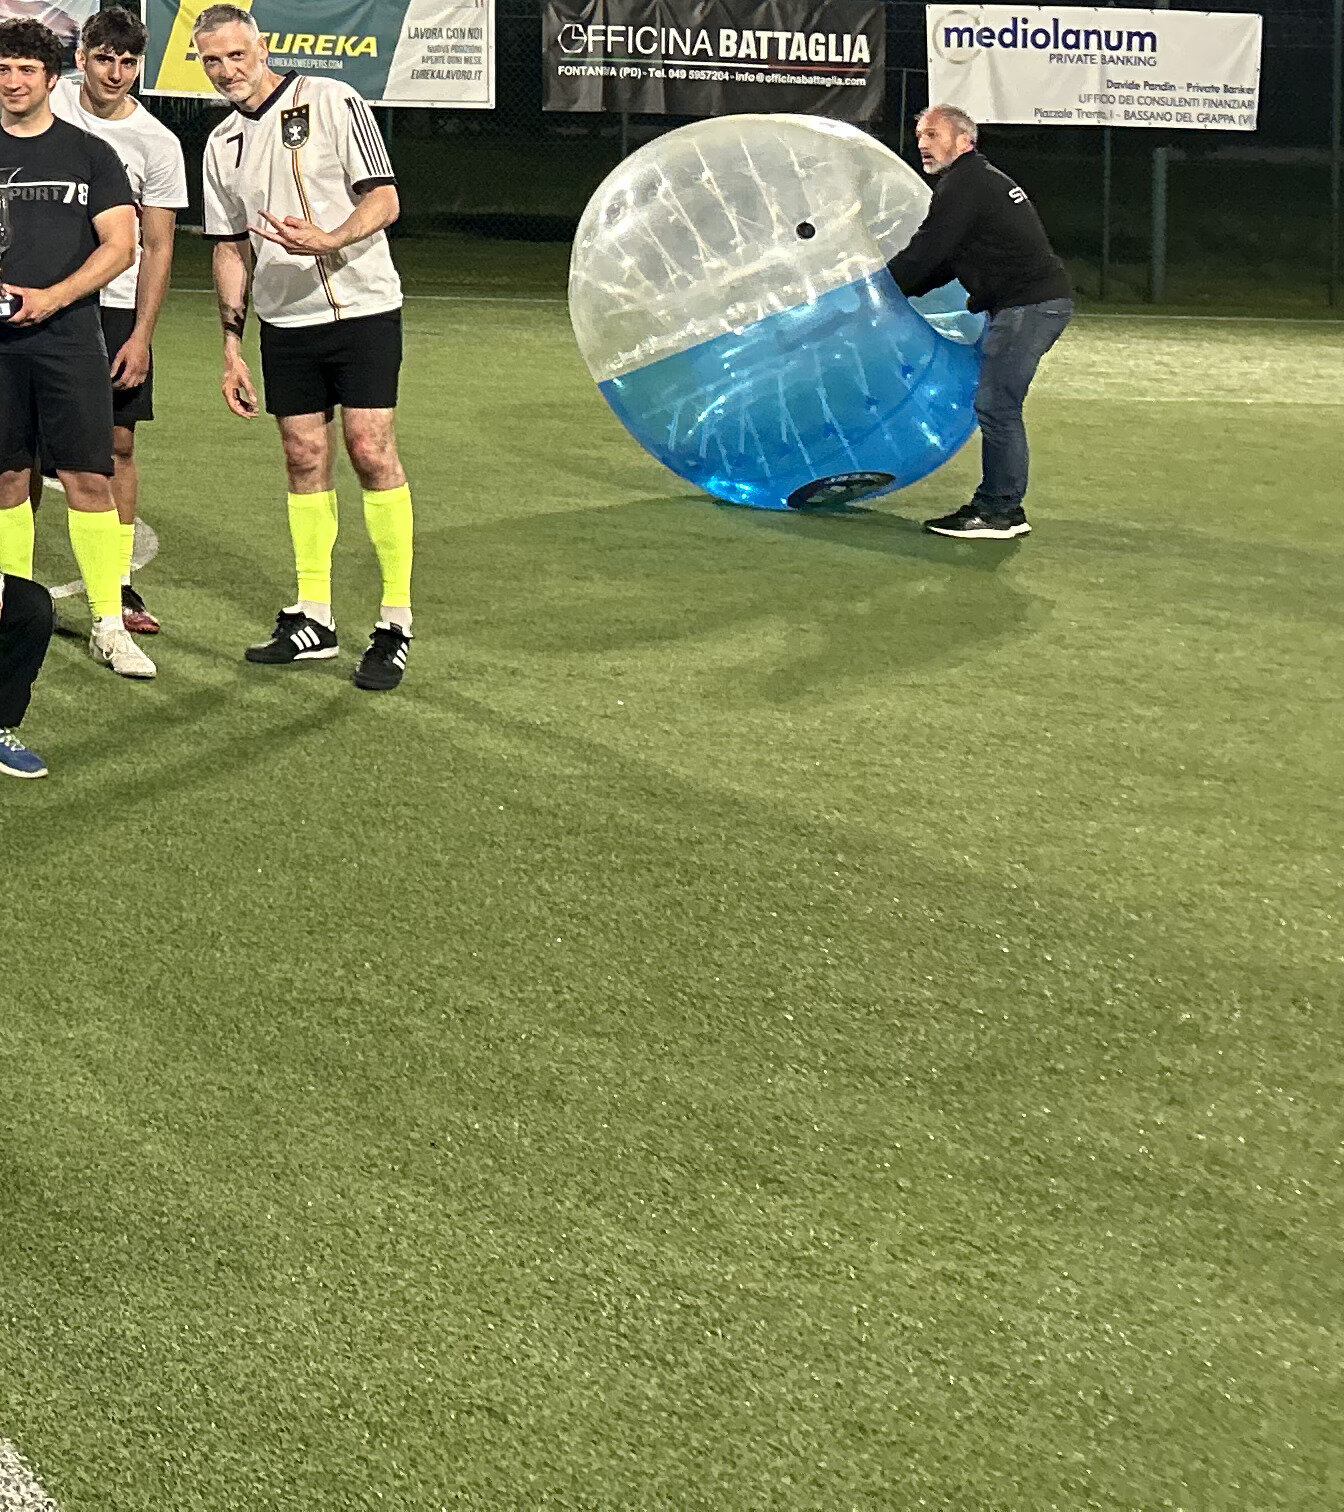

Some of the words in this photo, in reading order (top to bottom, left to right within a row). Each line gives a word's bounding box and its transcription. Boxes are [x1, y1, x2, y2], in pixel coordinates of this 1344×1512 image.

[407, 26, 443, 39] LAVORA
[446, 28, 465, 39] CON
[467, 28, 482, 40] NOI
[943, 16, 1157, 52] mediolanum
[558, 23, 713, 57] OFFICINA
[719, 28, 871, 63] BATTAGLIA
[1049, 53, 1097, 65] PRIVATE
[1101, 54, 1157, 67] BANKING
[620, 67, 642, 78] (PD)
[668, 69, 687, 79] 049
[1187, 83, 1221, 93] Private
[1119, 95, 1134, 105] DEI
[1137, 95, 1200, 107] CONSULENTI
[1034, 108, 1072, 119] Piazzale
[1124, 110, 1172, 122] BASSANO
[1175, 112, 1194, 122] DEL
[1197, 113, 1235, 125] GRAPPA
[226, 132, 243, 169] 7
